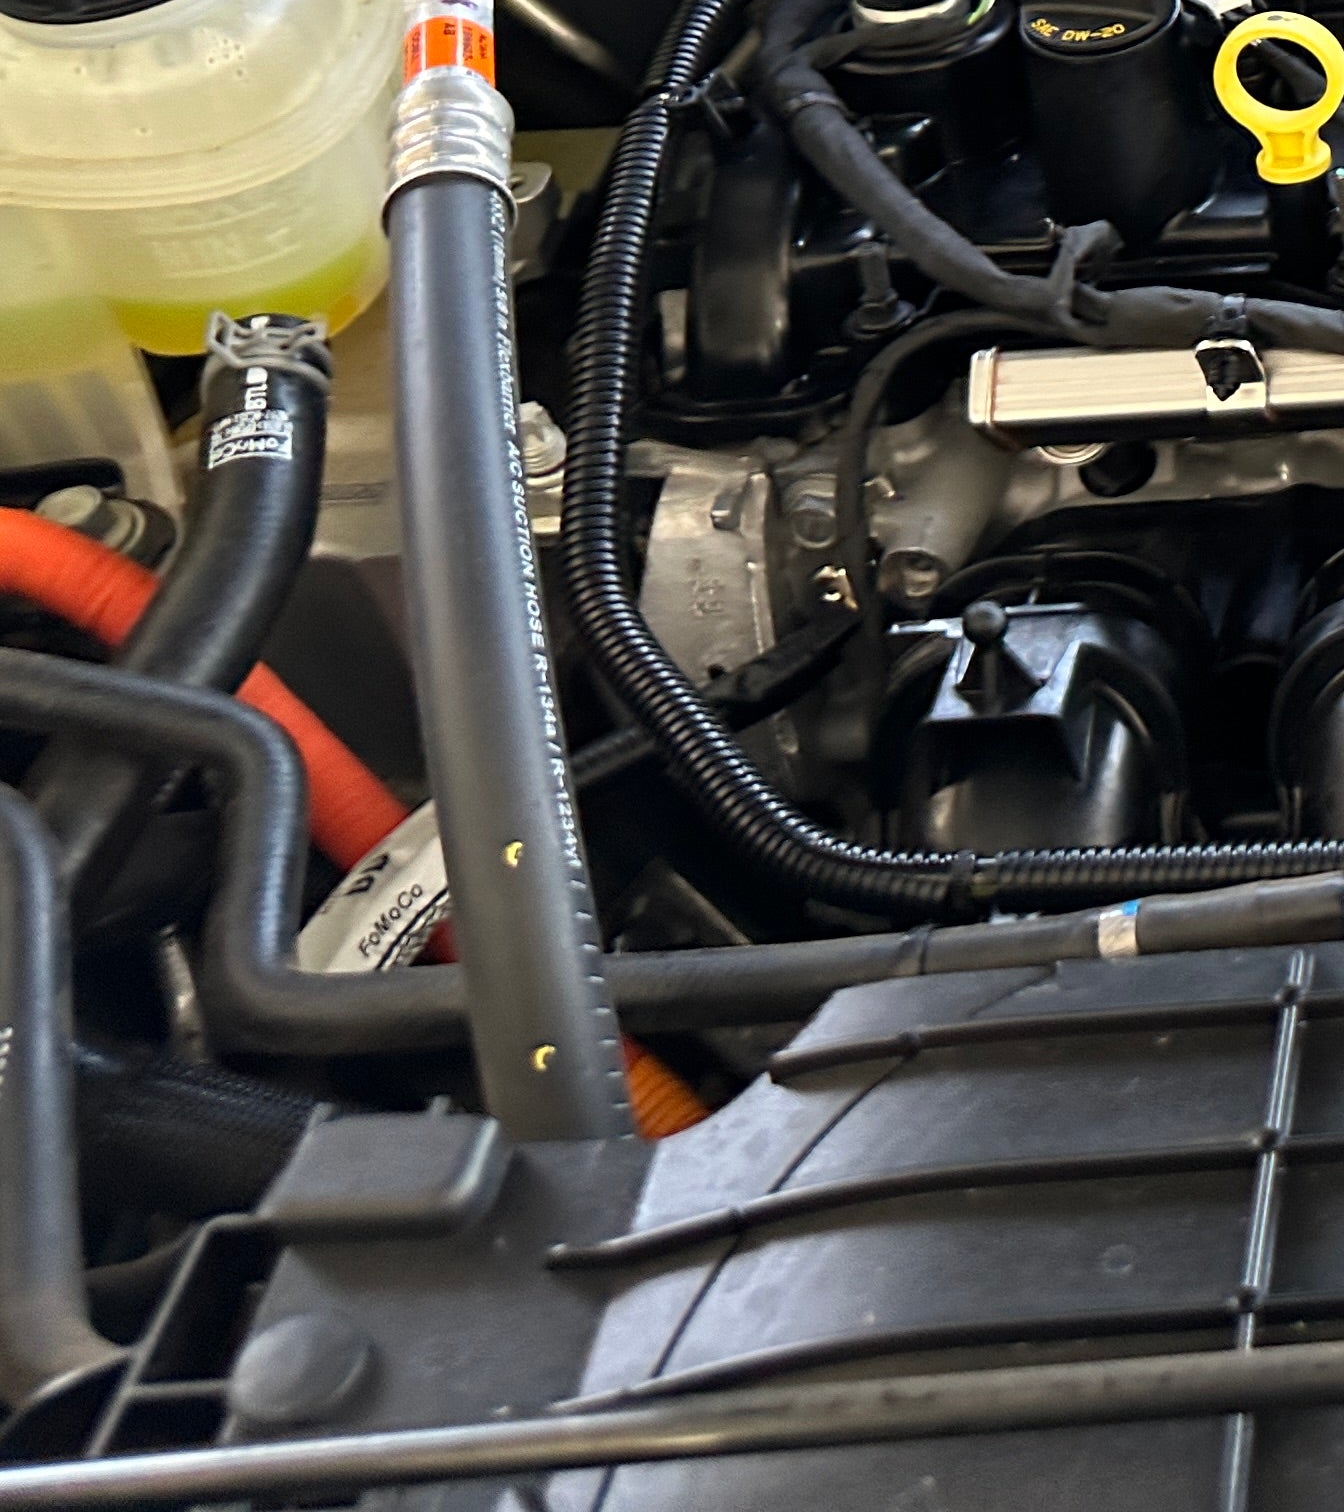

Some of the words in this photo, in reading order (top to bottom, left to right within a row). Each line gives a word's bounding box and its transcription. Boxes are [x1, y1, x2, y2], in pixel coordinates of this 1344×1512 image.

[1031, 18, 1059, 37] SAE
[496, 332, 516, 435] Flexbarrier
[507, 440, 523, 478] A/C
[512, 479, 535, 579] SUCTION
[524, 582, 545, 648] HOSE
[532, 653, 557, 738] R-134a
[549, 757, 582, 867] R-1234yf
[359, 883, 423, 958] FoMoCo
